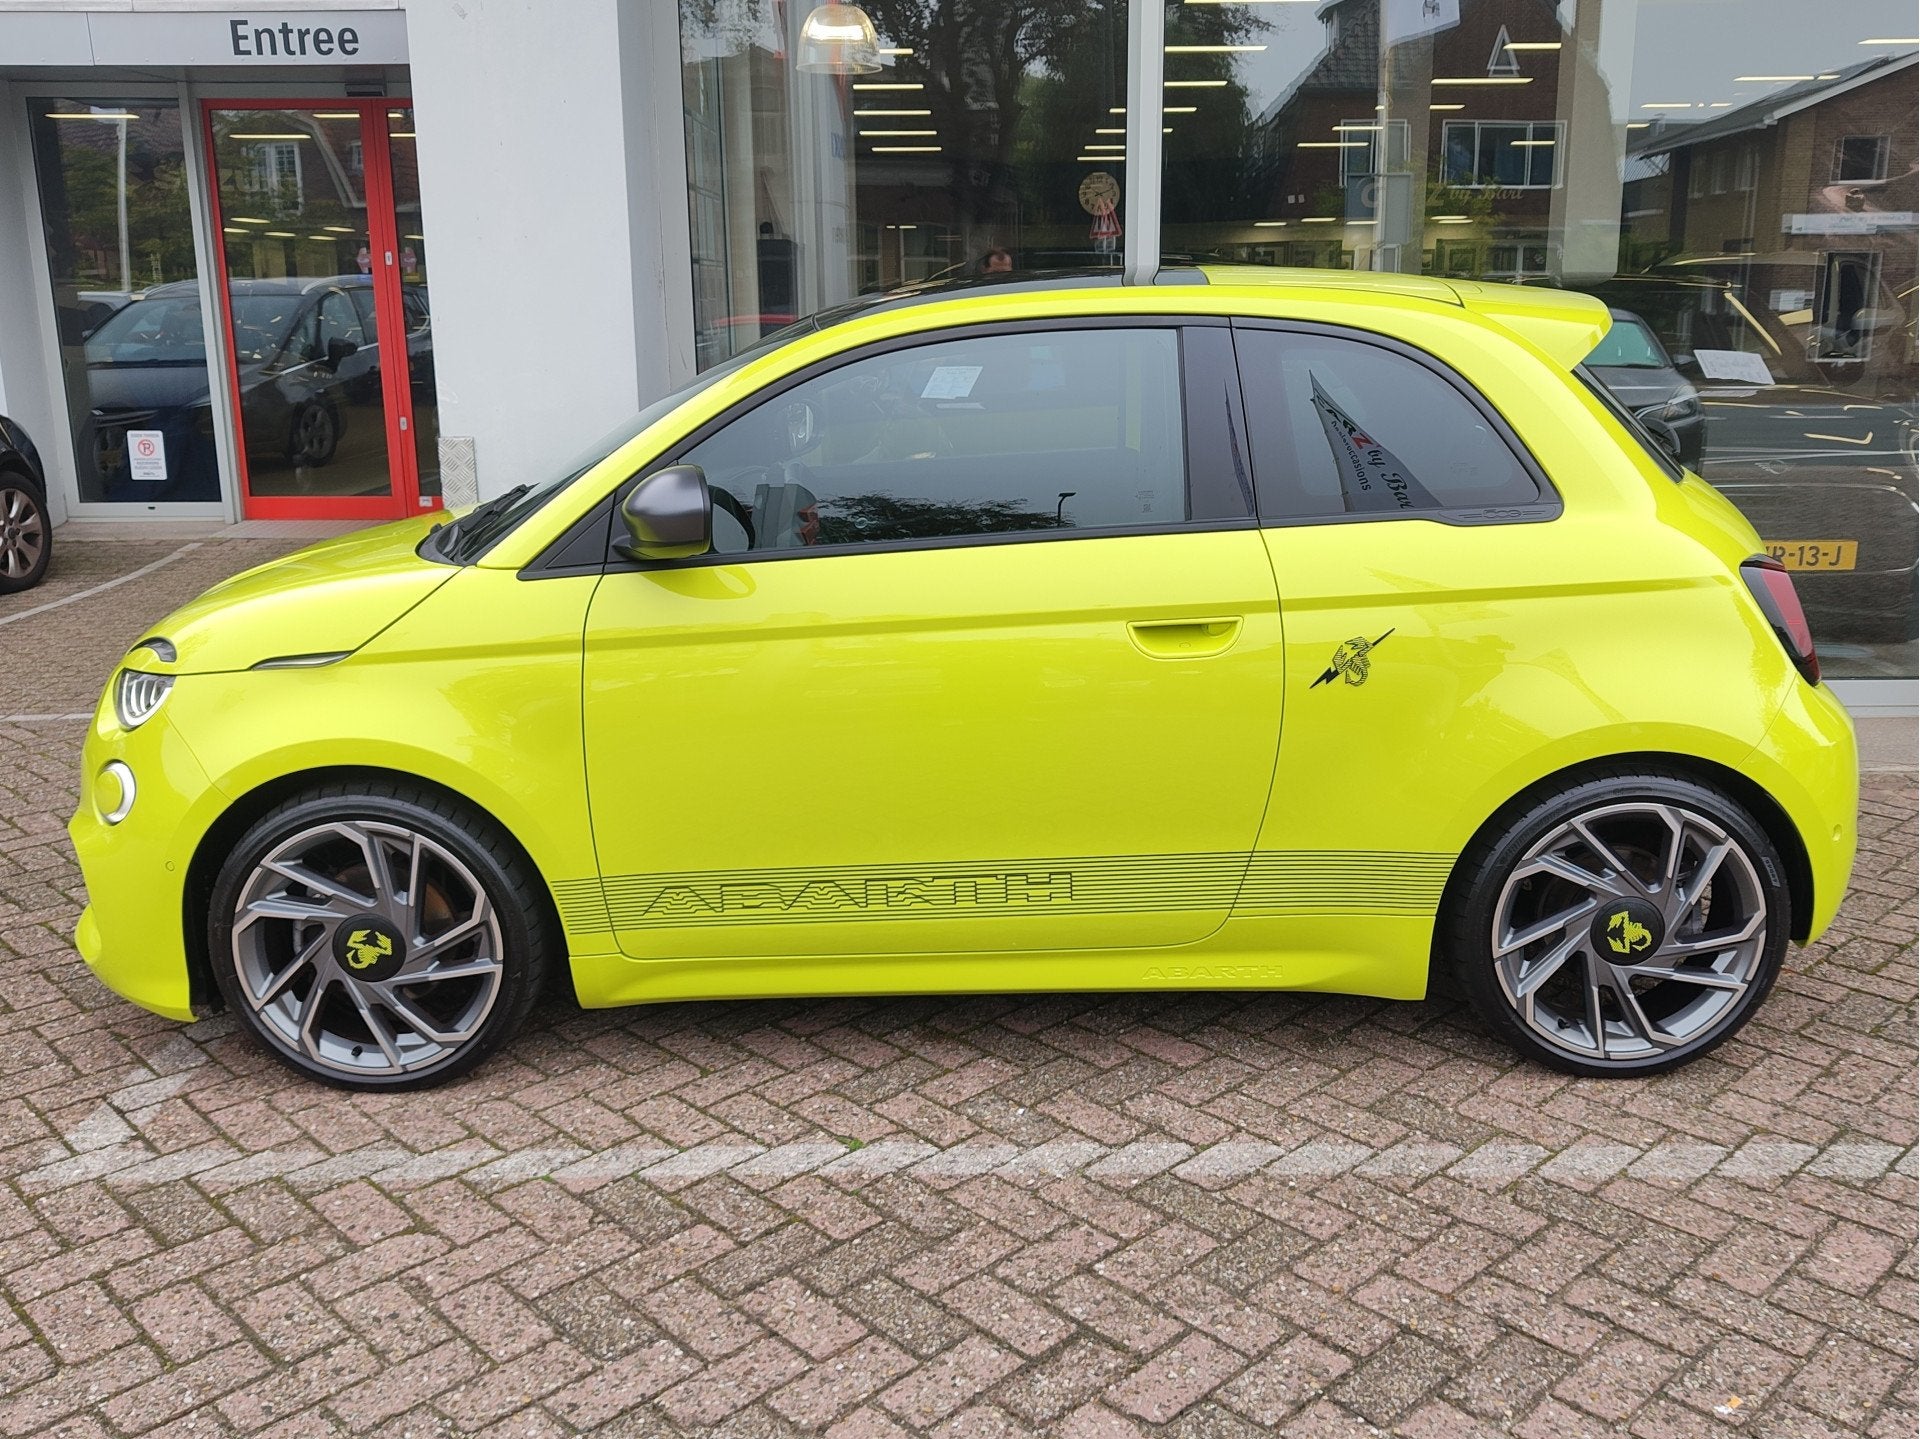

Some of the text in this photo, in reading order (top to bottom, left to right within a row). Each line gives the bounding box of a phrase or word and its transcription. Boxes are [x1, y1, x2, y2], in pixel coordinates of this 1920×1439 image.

[229, 19, 360, 56] Entree
[1367, 449, 1387, 469] by
[1381, 472, 1415, 510] Bar
[1765, 545, 1842, 567] R-13-J
[642, 872, 1073, 917] ABARTH
[1142, 965, 1284, 981] ABARTH
